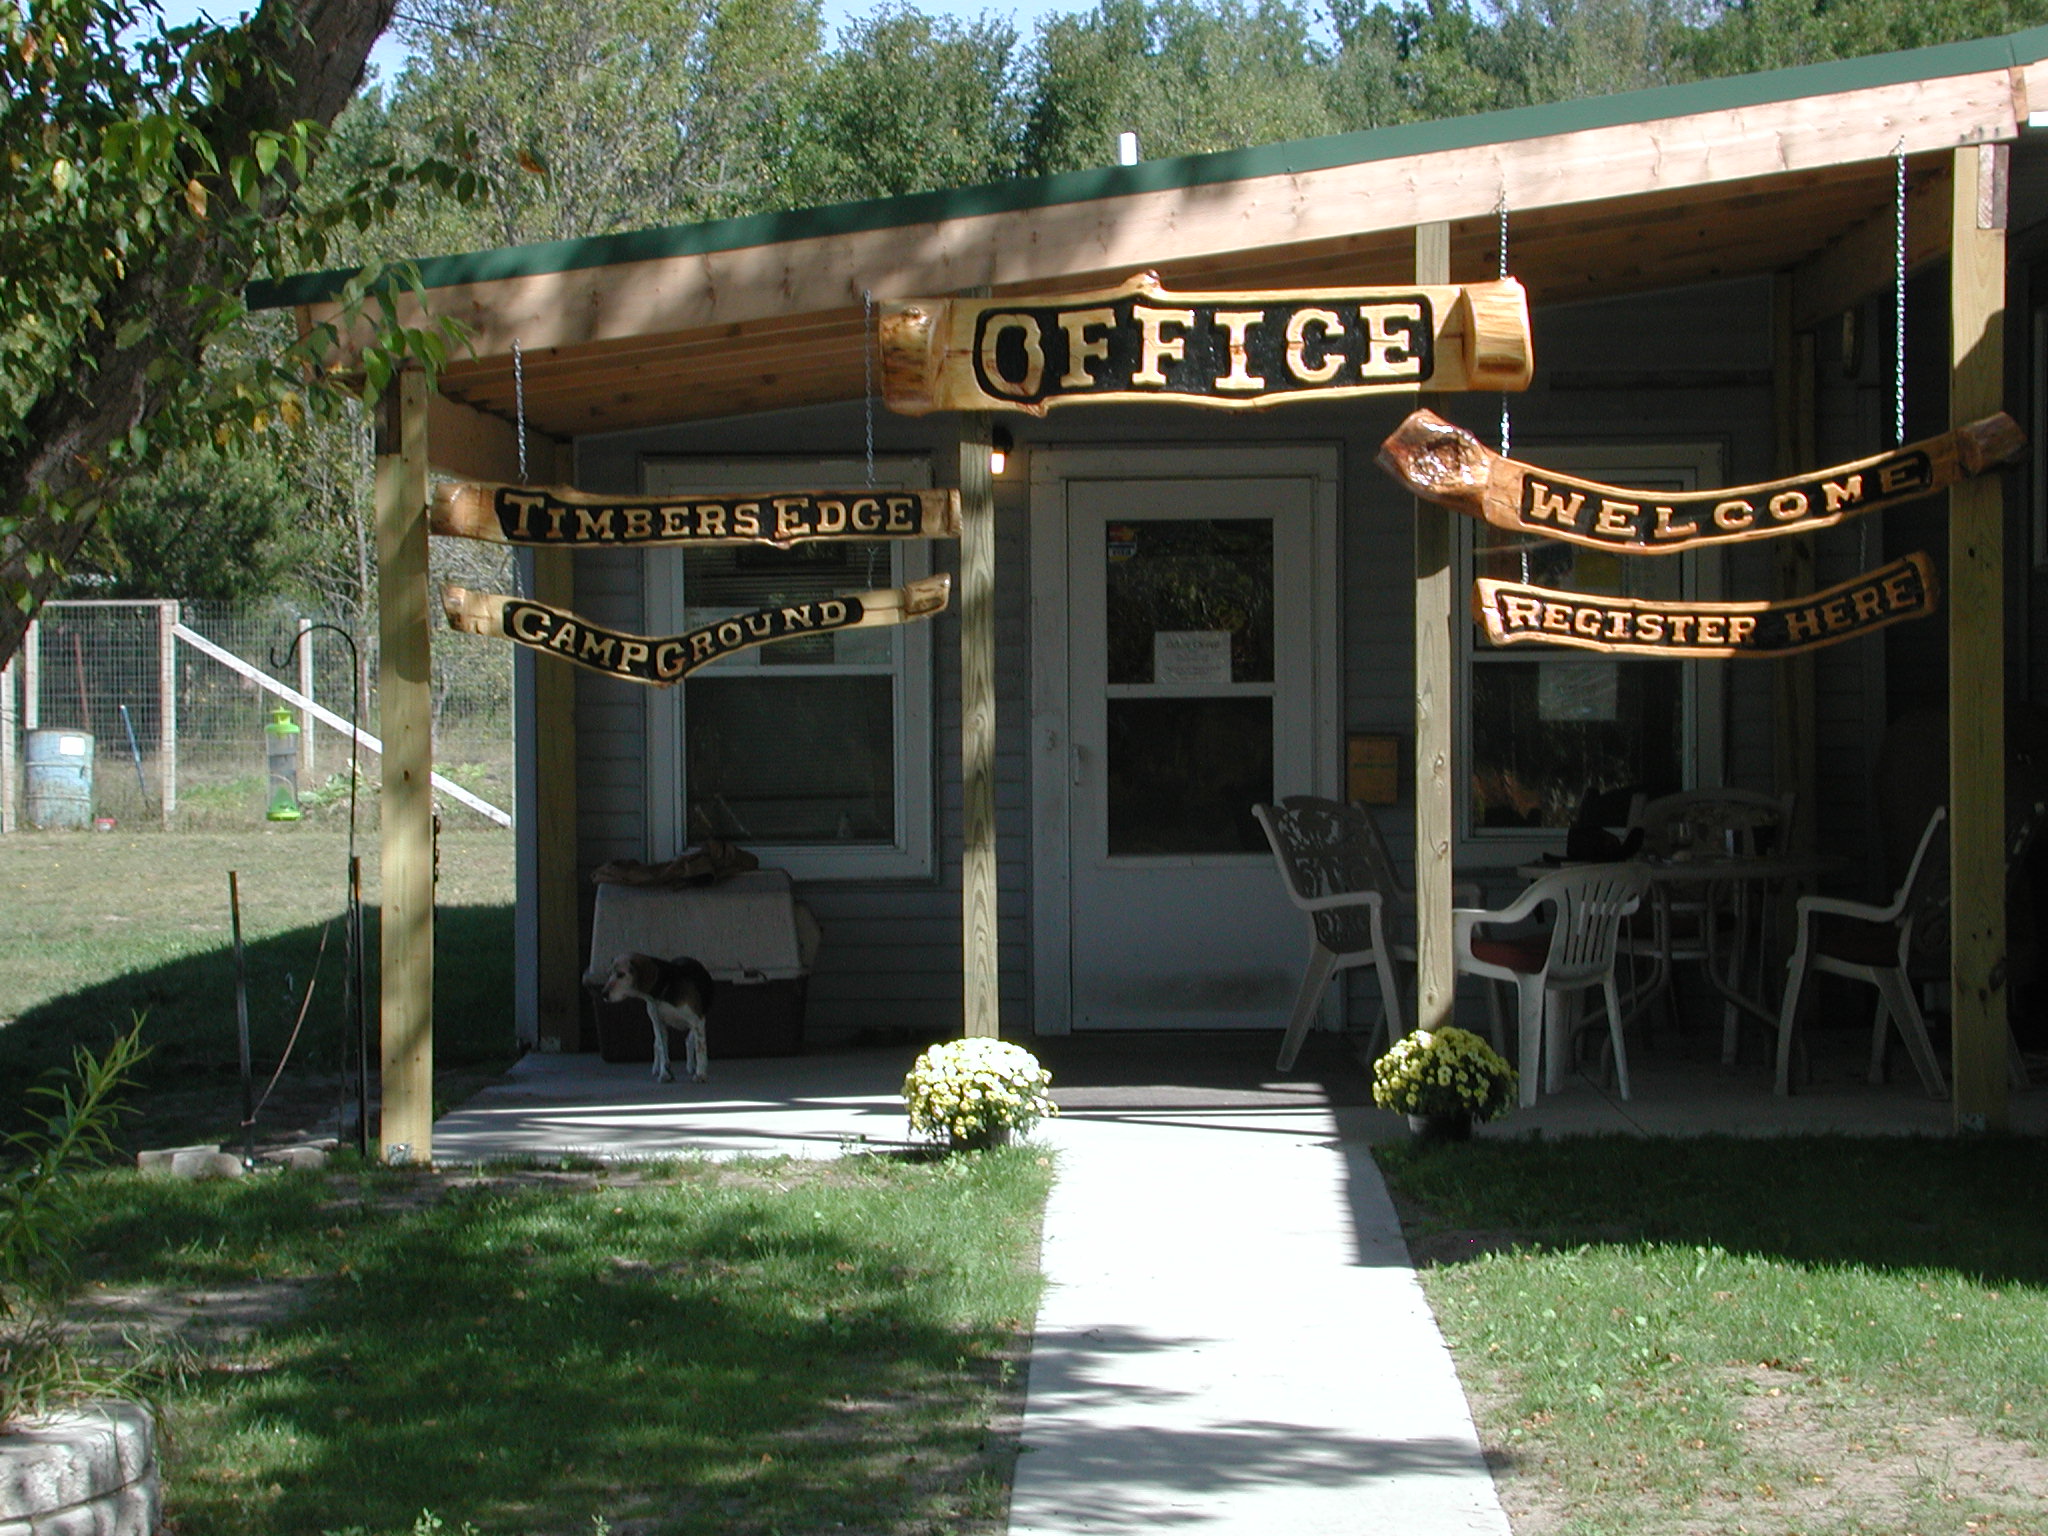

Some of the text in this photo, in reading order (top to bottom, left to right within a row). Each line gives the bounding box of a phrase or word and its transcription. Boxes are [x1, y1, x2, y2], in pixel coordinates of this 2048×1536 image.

[981, 303, 1421, 396] OFFICE
[503, 496, 914, 541] TIMBERS EDGE
[1529, 457, 1923, 538] WELCOME
[511, 599, 848, 679] CAMPGROUND
[1503, 575, 1922, 645] REGISTER HERE
